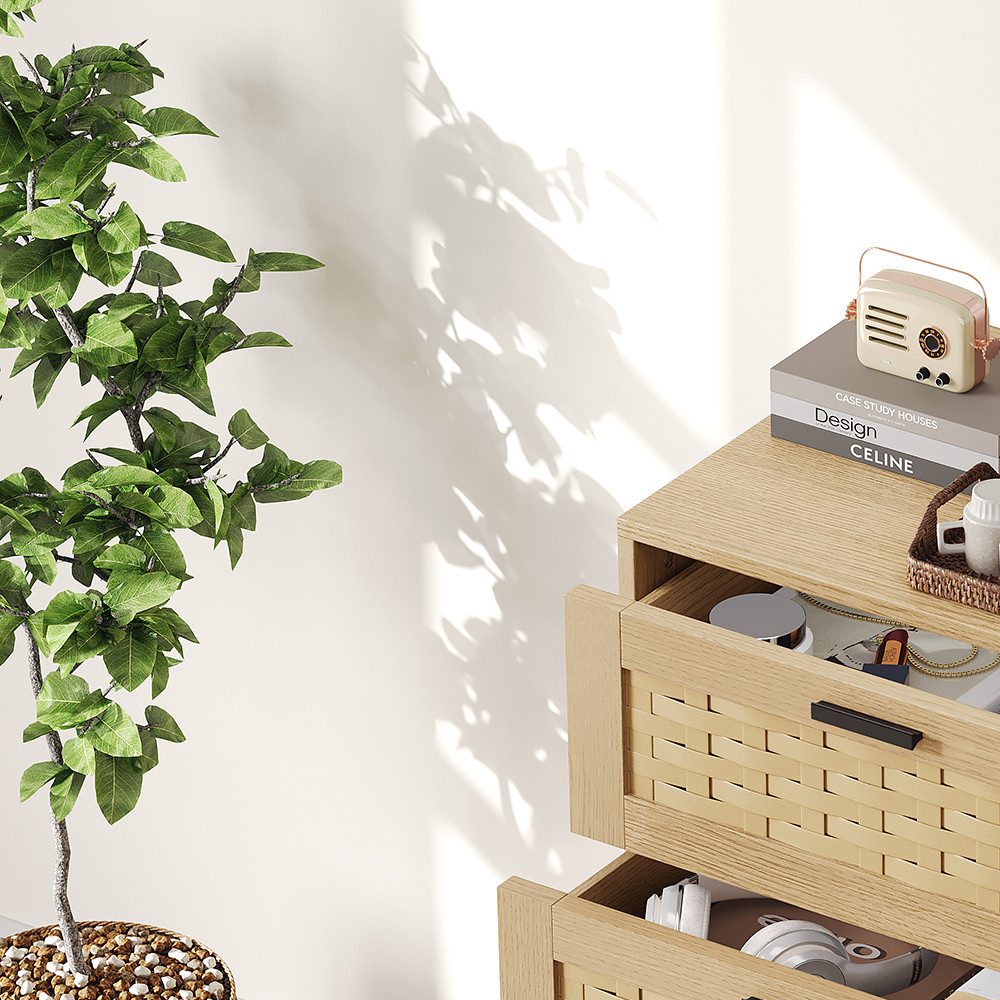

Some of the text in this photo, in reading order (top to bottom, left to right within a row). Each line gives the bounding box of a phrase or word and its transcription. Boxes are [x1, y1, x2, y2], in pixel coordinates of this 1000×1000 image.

[815, 407, 877, 439] Design
[835, 392, 861, 407] CASE
[864, 400, 895, 416] STUDY
[898, 410, 938, 430] HOUSES
[850, 444, 914, 474] CELINE
